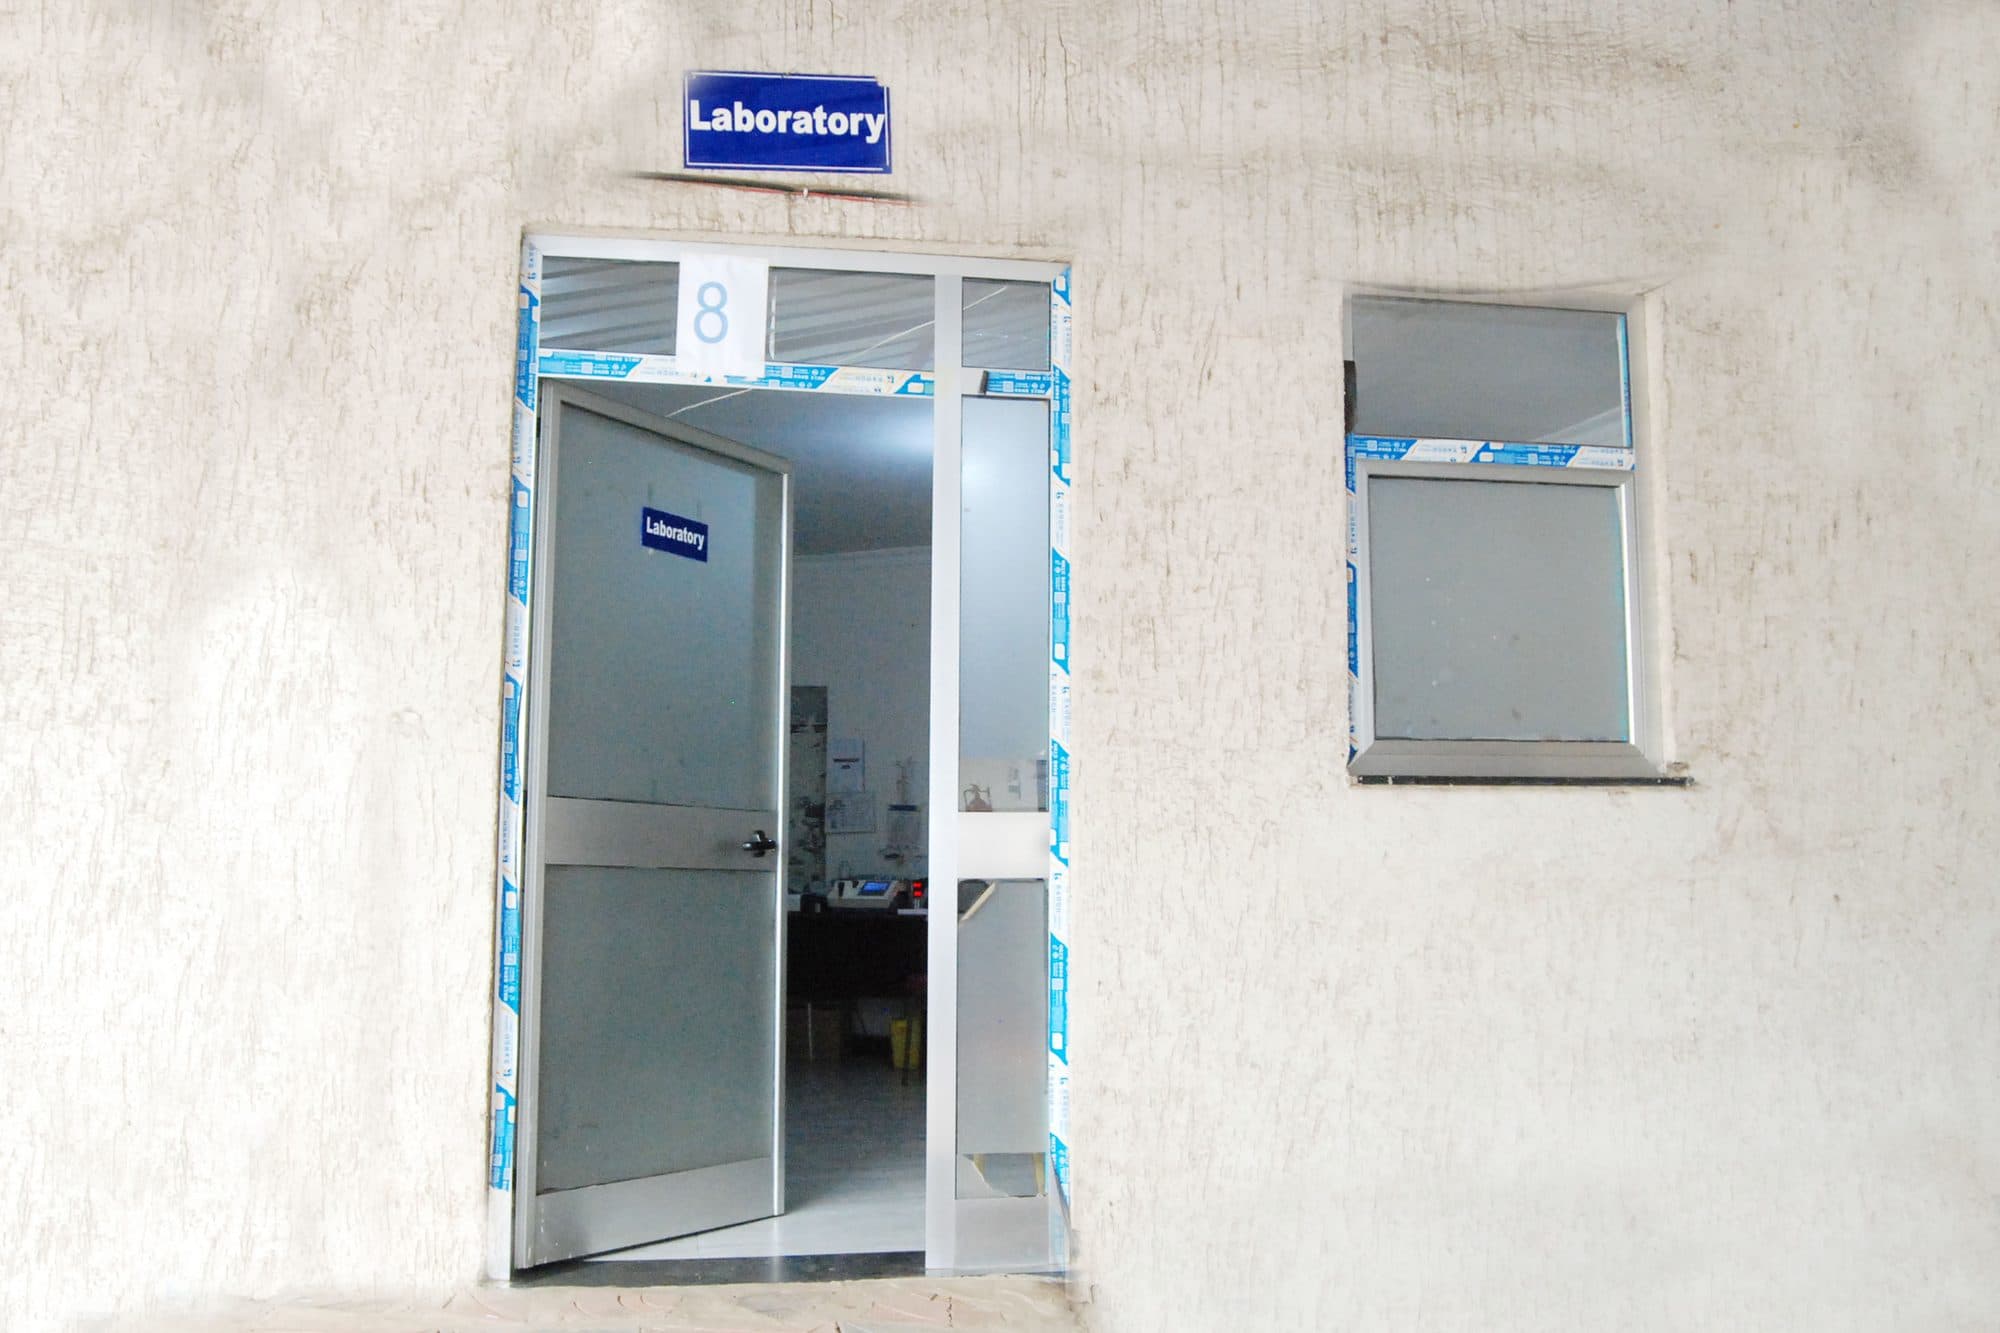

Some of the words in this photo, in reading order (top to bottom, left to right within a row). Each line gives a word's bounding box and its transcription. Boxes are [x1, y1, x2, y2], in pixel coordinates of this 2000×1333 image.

[690, 99, 885, 144] Laboratory
[693, 281, 728, 345] 8
[646, 516, 705, 551] Laboratory
